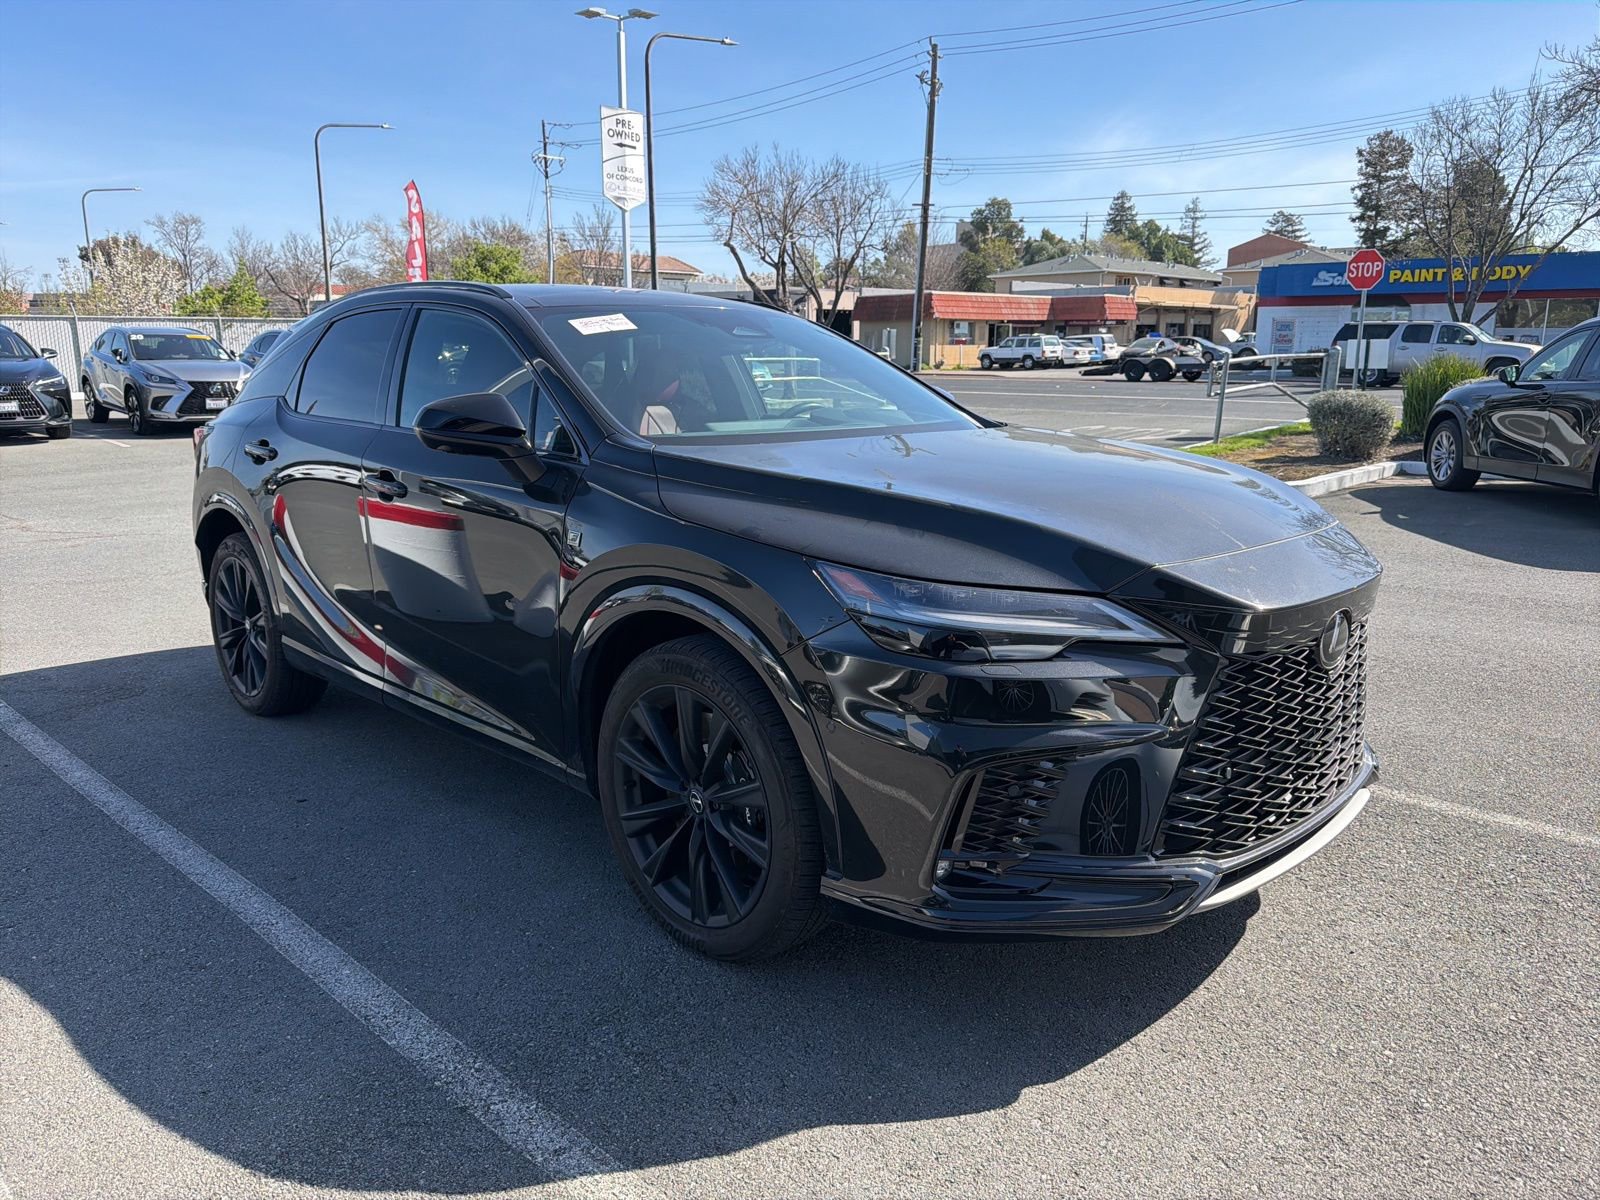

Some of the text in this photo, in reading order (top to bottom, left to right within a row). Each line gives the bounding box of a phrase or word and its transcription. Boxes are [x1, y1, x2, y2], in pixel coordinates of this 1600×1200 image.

[615, 118, 634, 129] PRE-
[607, 128, 640, 142] OWNED
[617, 166, 634, 174] LEXUS
[606, 172, 643, 183] OF CONCORD
[1349, 261, 1382, 278] STOP
[1389, 268, 1447, 283] PAINT
[1452, 267, 1464, 281] &
